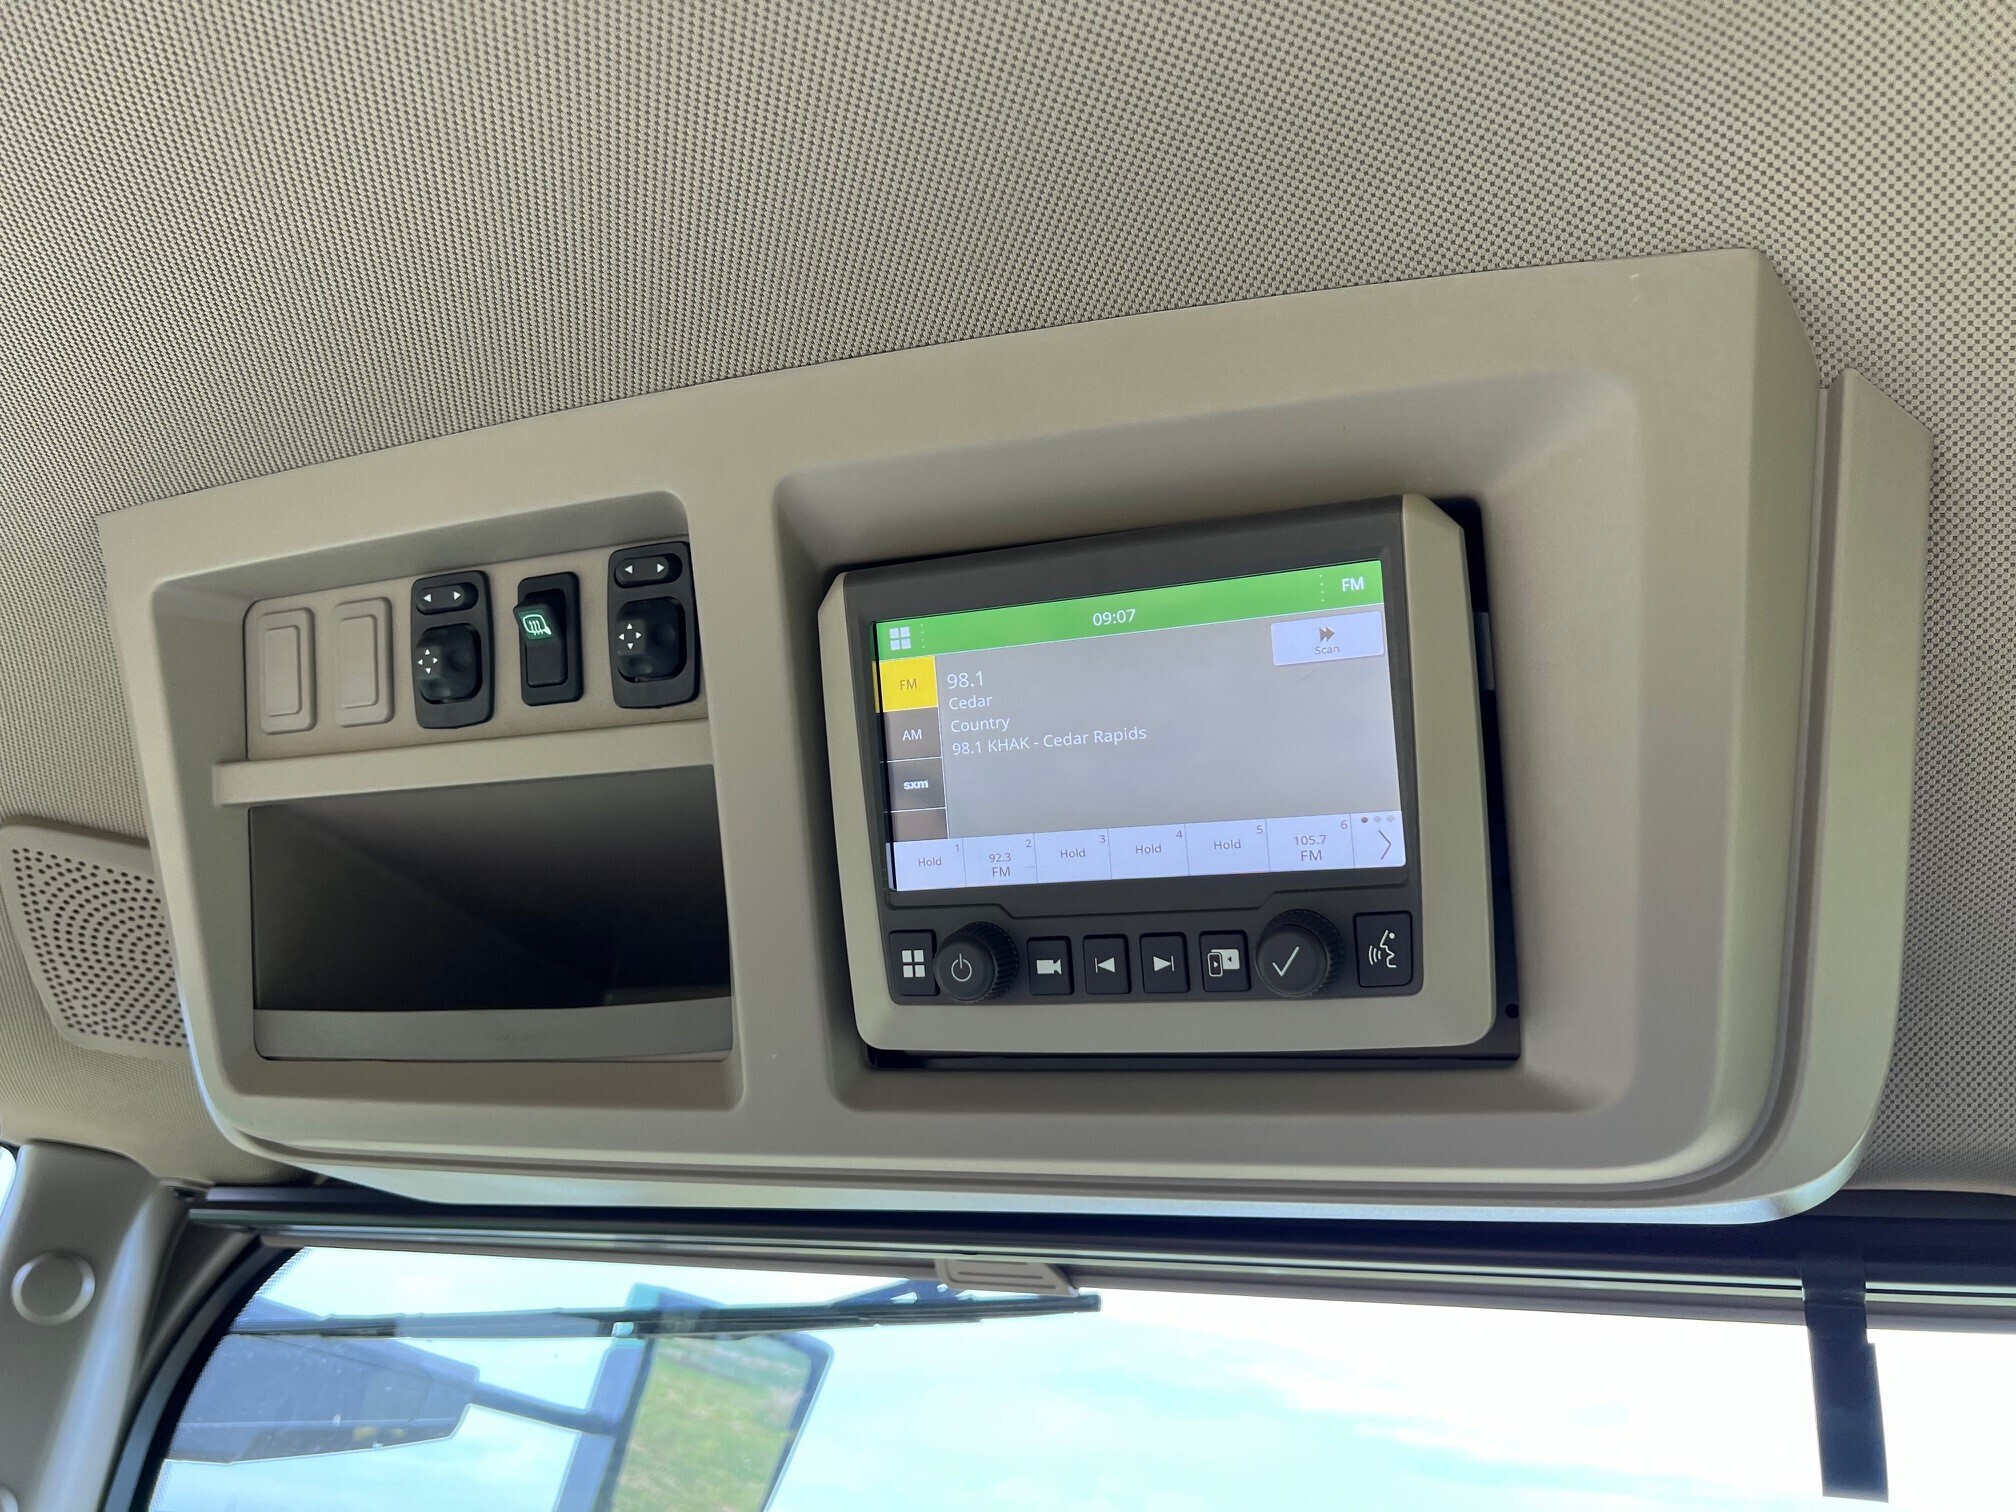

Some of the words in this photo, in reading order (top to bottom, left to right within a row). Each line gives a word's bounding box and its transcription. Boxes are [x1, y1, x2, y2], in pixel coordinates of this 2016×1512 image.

[1341, 576, 1365, 593] FM
[1092, 608, 1137, 627] 09:07
[1314, 643, 1340, 655] Scan
[899, 677, 918, 691] FM
[947, 670, 985, 690] 98.1
[948, 694, 993, 711] Cedar
[950, 715, 1011, 733] Country
[902, 728, 923, 742] AM
[951, 739, 982, 756] 98.1
[987, 737, 1029, 753] KHAK
[1042, 730, 1089, 749] Cedar
[1093, 725, 1147, 746] Rapids
[903, 778, 929, 790] sxm
[1256, 825, 1263, 834] 5
[1340, 820, 1348, 830] 6
[1099, 834, 1106, 844] 3
[1175, 830, 1183, 839] 4
[1293, 834, 1327, 847] 105.7
[955, 844, 960, 852] 1
[1025, 839, 1032, 848] 2
[1134, 843, 1162, 855] Hold
[1213, 838, 1242, 851] Hold
[988, 852, 1012, 864] 92.3
[1060, 847, 1086, 859] Hold
[1300, 848, 1322, 862] FM
[918, 855, 942, 868] Hold
[992, 866, 1011, 879] FM
